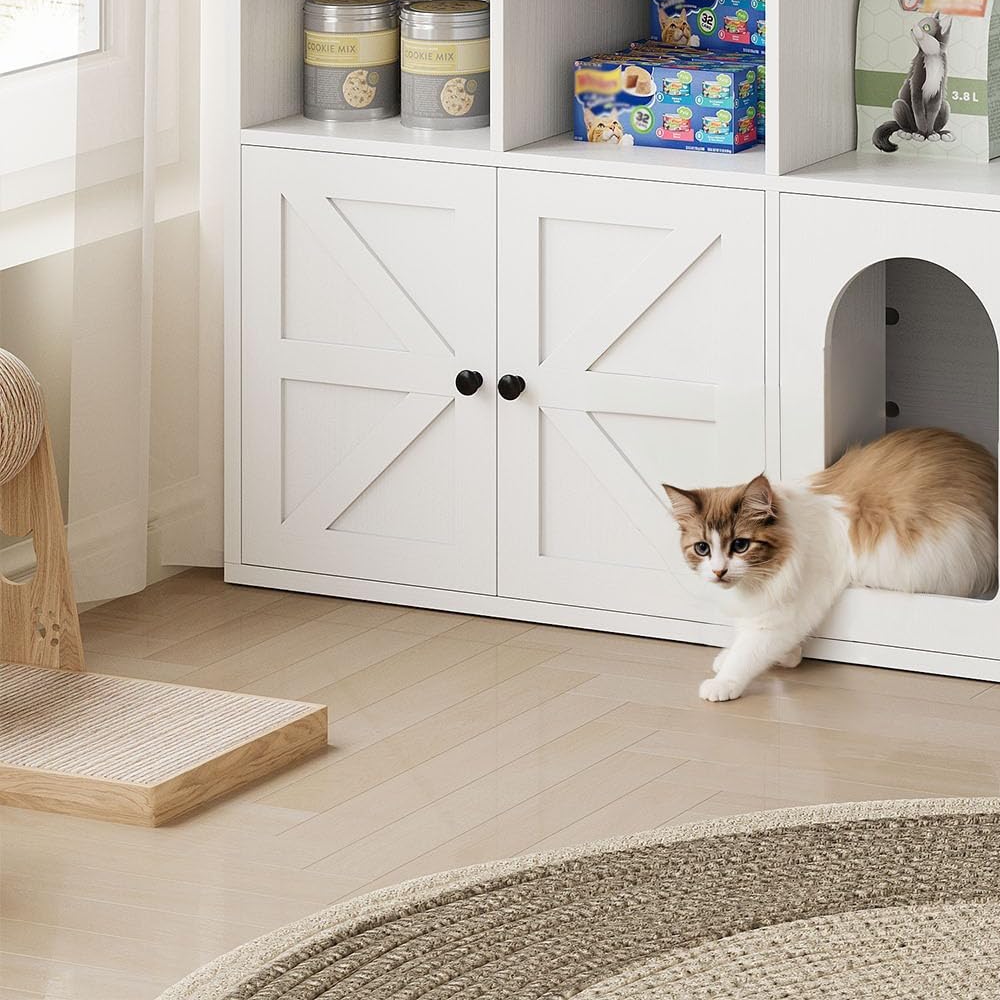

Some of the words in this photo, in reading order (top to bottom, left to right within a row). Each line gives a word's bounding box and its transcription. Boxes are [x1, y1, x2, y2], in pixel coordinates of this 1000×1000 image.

[701, 12, 714, 26] 32
[307, 41, 335, 53] COOKIE
[338, 44, 356, 54] MIX
[405, 50, 433, 60] COOKIE
[435, 52, 454, 61] MIX
[951, 90, 970, 101] 3.8
[972, 91, 979, 102] L
[635, 111, 650, 124] 32
